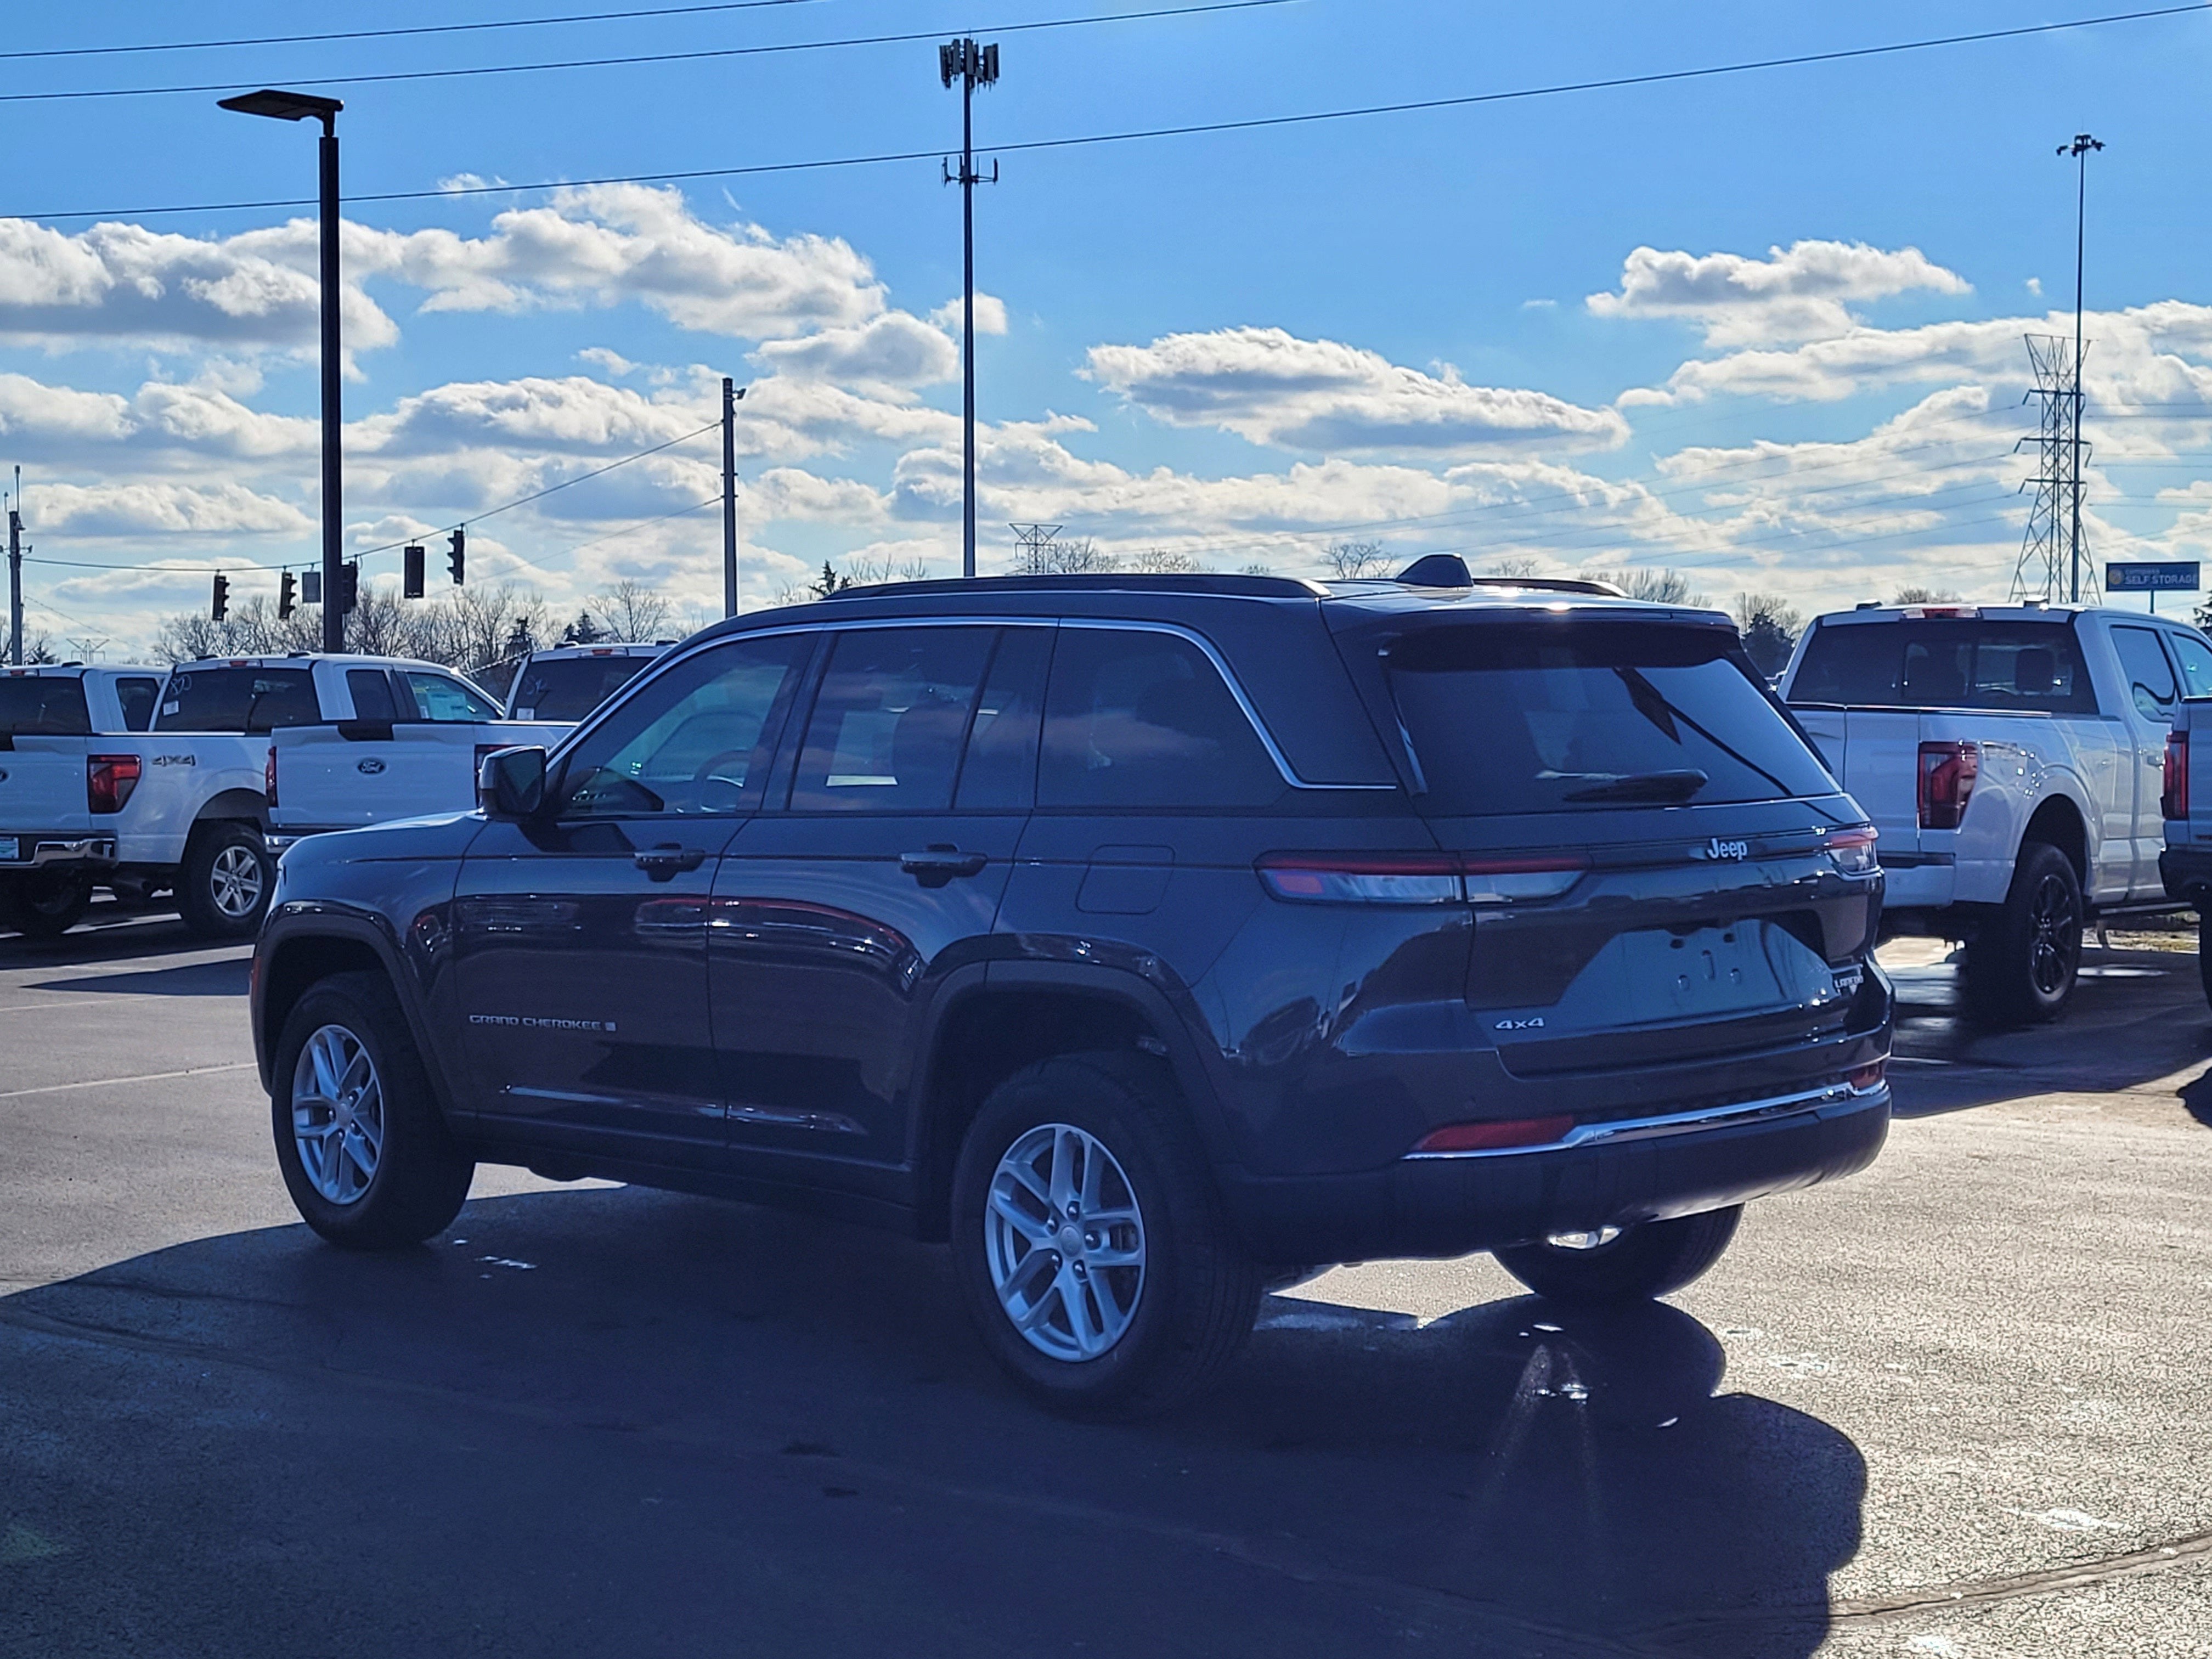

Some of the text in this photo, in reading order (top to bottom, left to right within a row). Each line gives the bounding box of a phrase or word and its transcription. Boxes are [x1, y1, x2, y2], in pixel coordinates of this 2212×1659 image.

[2125, 573, 2198, 584] SELF STORAGE
[360, 760, 382, 773] Ford
[1707, 837, 1748, 861] Jeep
[469, 1015, 601, 1030] GRAND CHEROKEE
